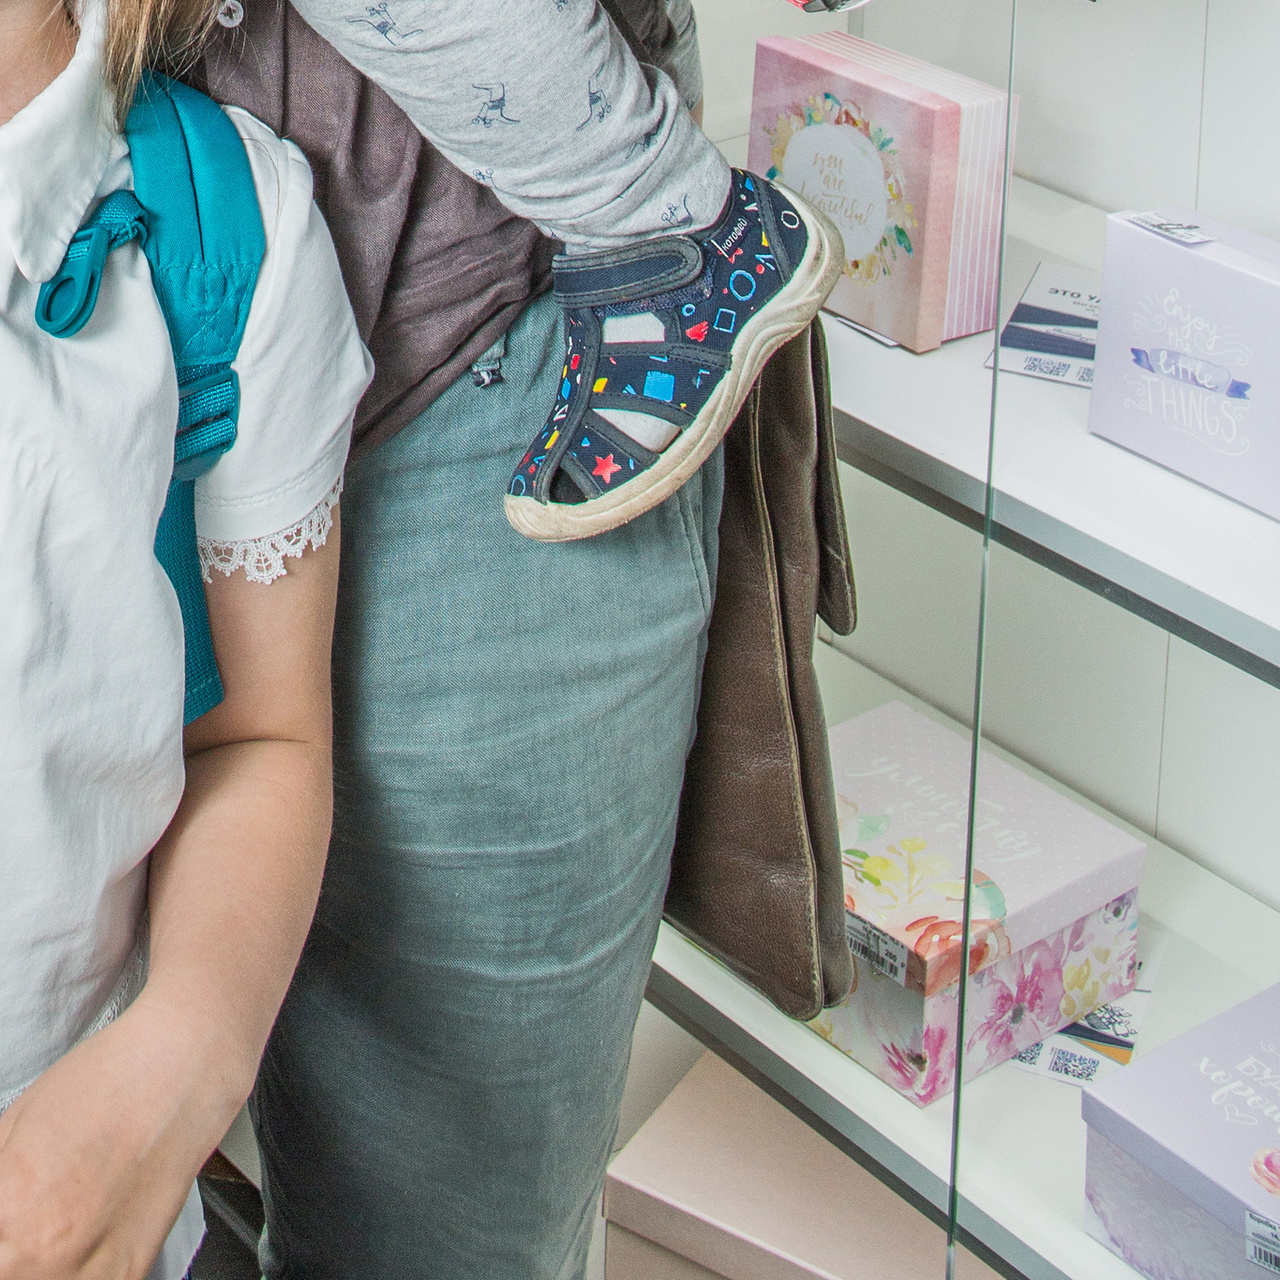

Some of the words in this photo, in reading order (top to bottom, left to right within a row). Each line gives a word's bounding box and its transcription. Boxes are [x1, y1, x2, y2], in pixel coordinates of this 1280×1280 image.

[1048, 286, 1082, 299] ЭТО
[1163, 288, 1219, 351] Enjoy
[1158, 349, 1220, 389] little
[1140, 374, 1237, 444] THINGS
